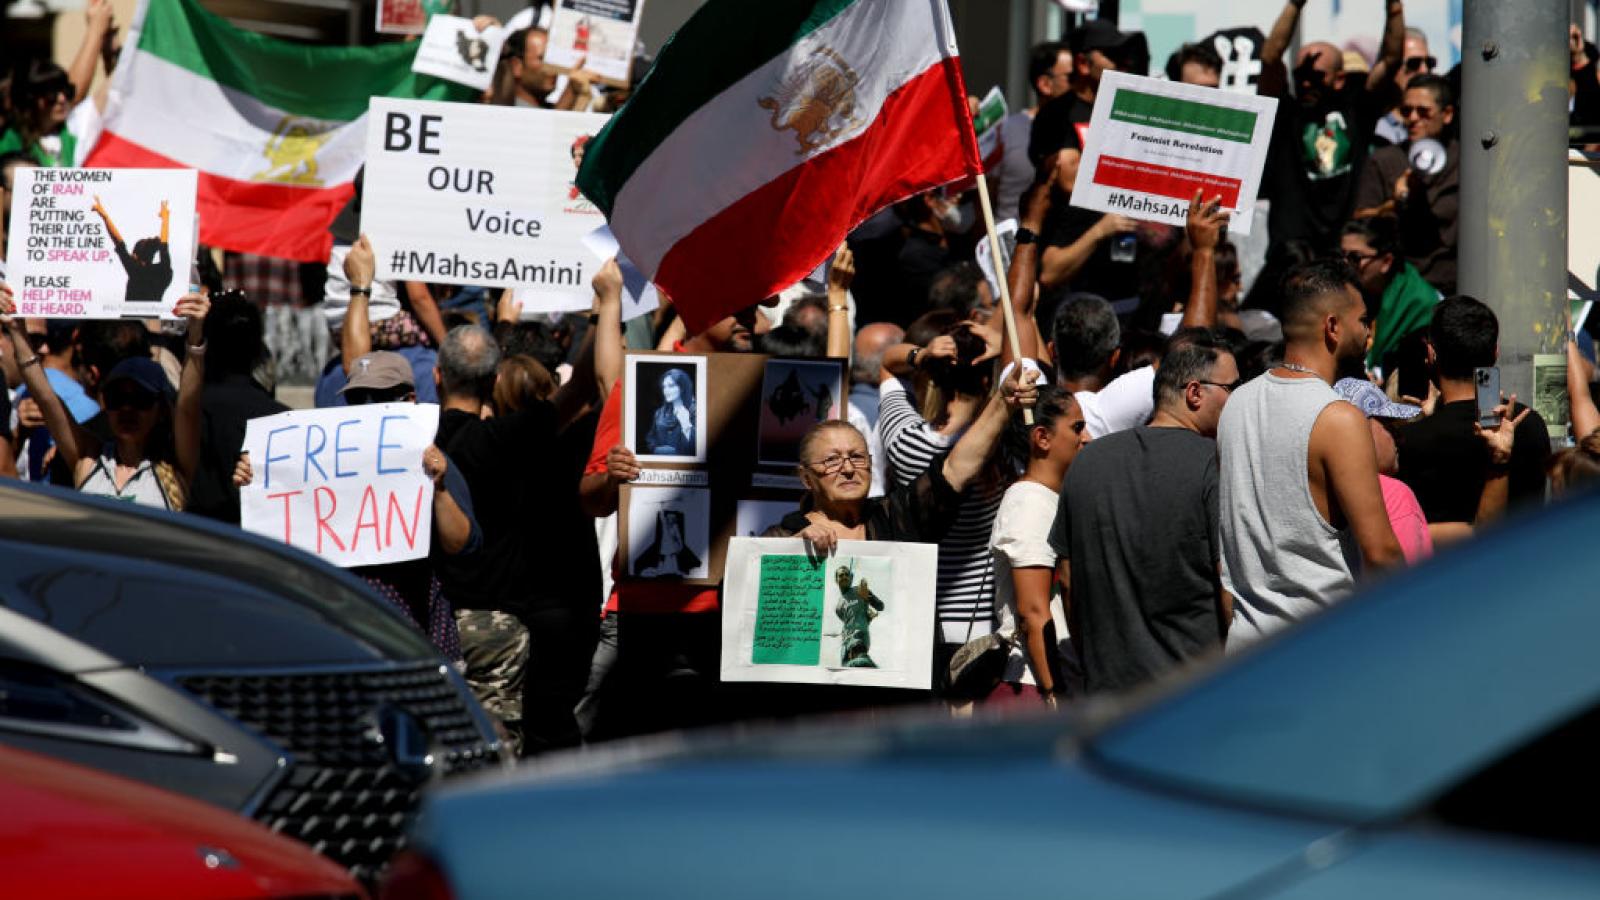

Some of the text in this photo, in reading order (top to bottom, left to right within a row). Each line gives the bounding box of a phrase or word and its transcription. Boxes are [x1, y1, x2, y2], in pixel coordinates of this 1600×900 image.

[384, 111, 443, 155] BE
[1130, 131, 1171, 147] Feminist
[1172, 139, 1225, 156] Revolution
[33, 170, 112, 182] THE WOMEN
[427, 166, 495, 195] OUR
[32, 183, 84, 195] OF IRAN
[30, 196, 56, 208] ARE
[1107, 192, 1190, 218] #MahsaA
[29, 210, 85, 222] PUTTING
[465, 207, 542, 237] Voice
[29, 223, 101, 235] THEIR LIVES
[27, 236, 105, 249] ON THE LINE
[27, 249, 113, 263] TO SPEAK UP.
[390, 249, 583, 286] #MahsaAmini
[24, 275, 71, 288] PLEASE
[22, 289, 92, 301] HELP THEM
[21, 302, 87, 315] BE HEARD.
[264, 416, 409, 489] FREE
[638, 471, 708, 482] MahsaAmini
